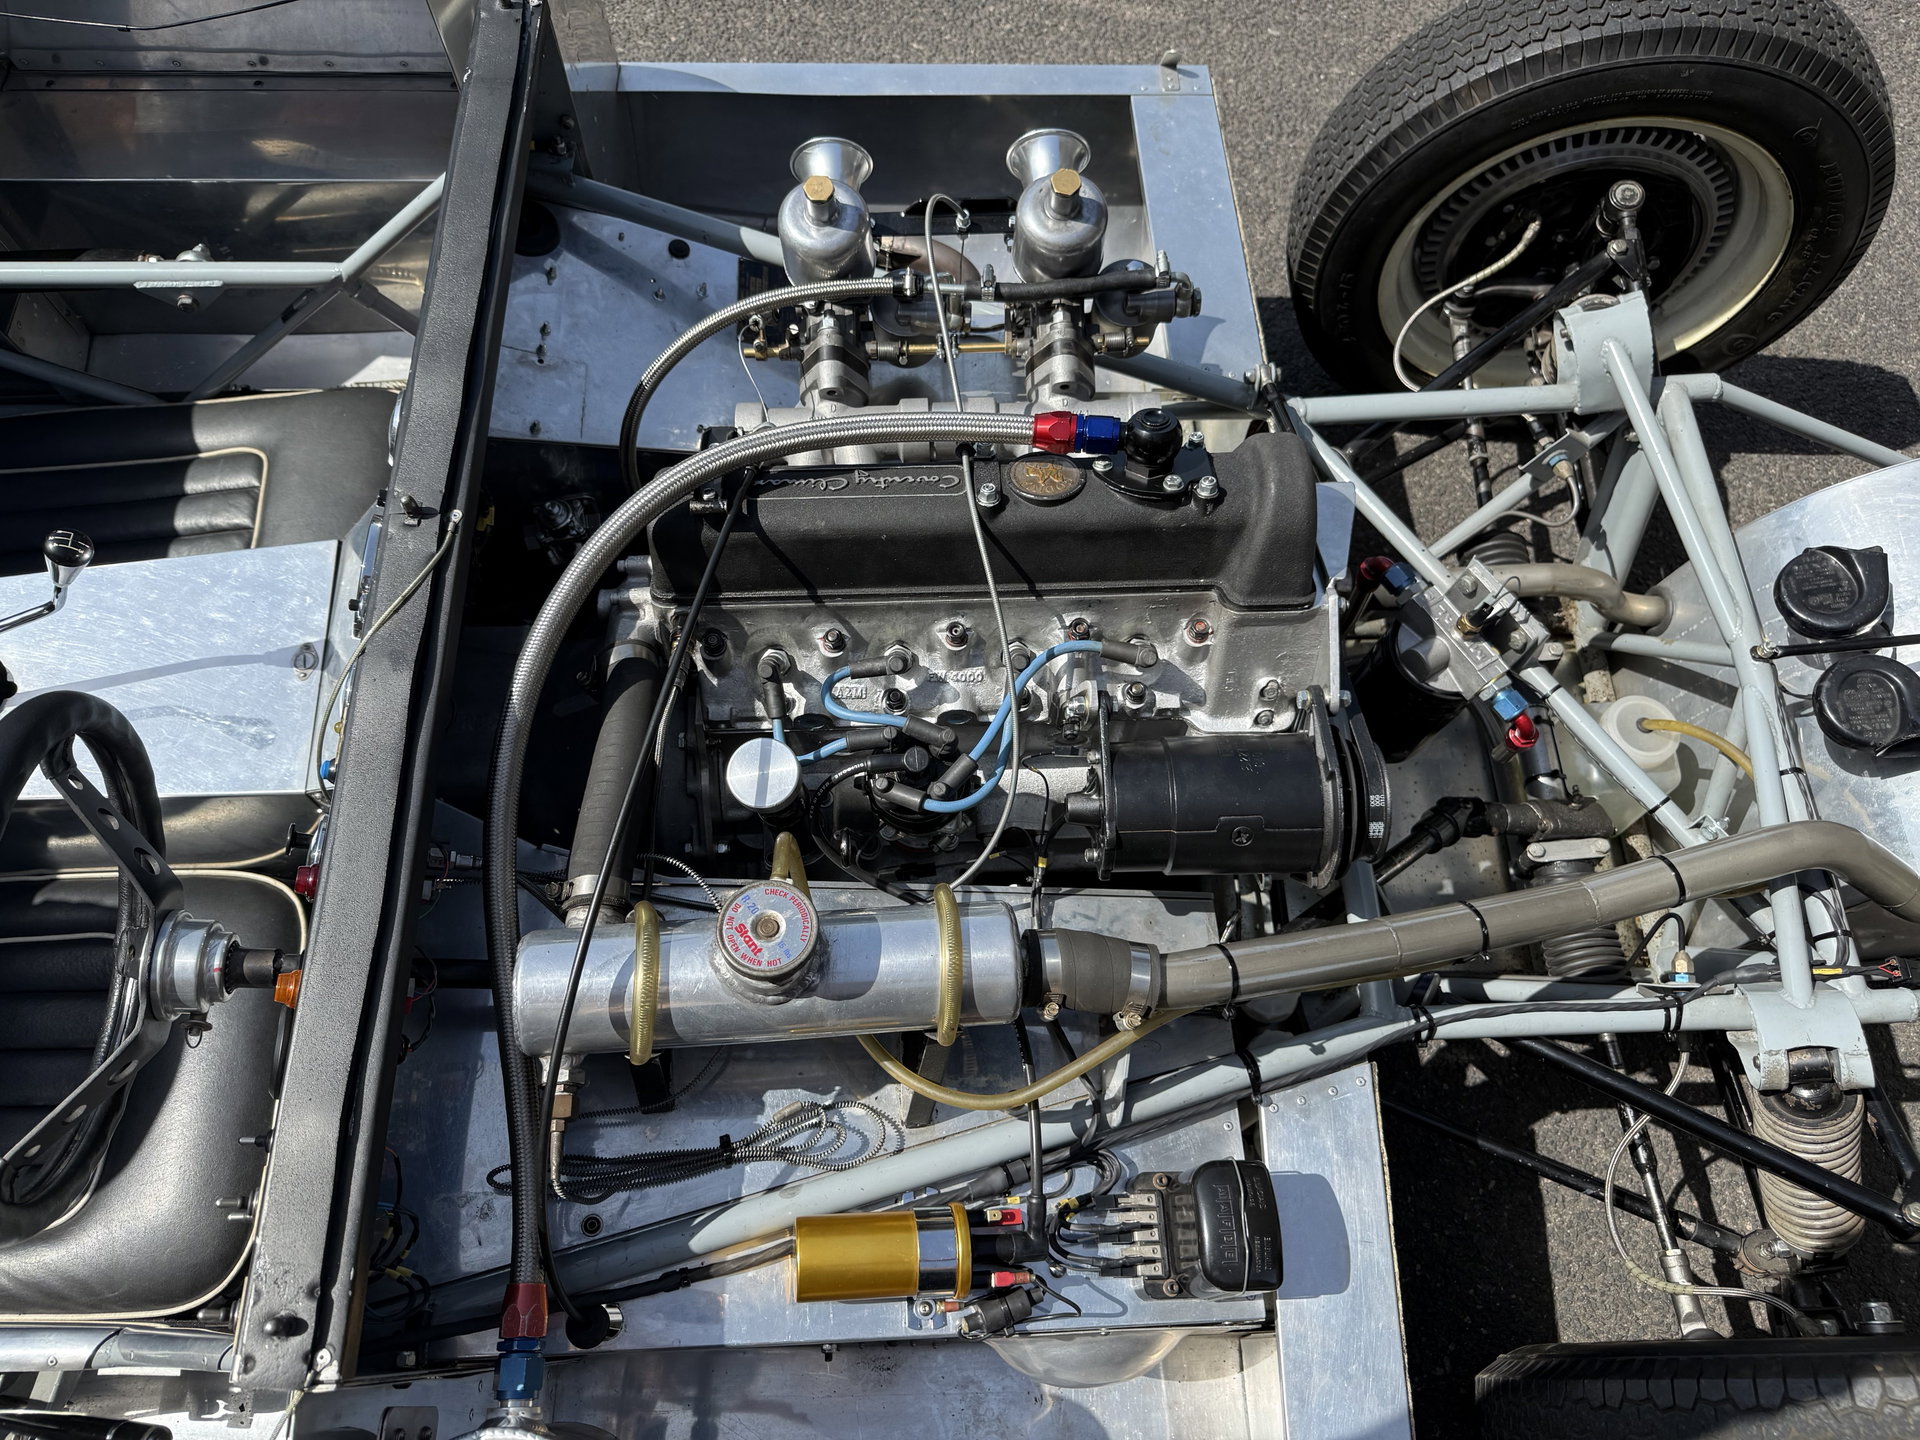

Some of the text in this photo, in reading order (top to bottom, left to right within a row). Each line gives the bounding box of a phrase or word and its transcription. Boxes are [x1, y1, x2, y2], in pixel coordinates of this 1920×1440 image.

[753, 470, 960, 490] Coventry Climax
[741, 894, 760, 915] R-20
[764, 888, 810, 943] CHECK PERIODICALLY
[726, 902, 782, 967] DO NOT OPEN WHEN HOT
[734, 923, 763, 957] Stant
